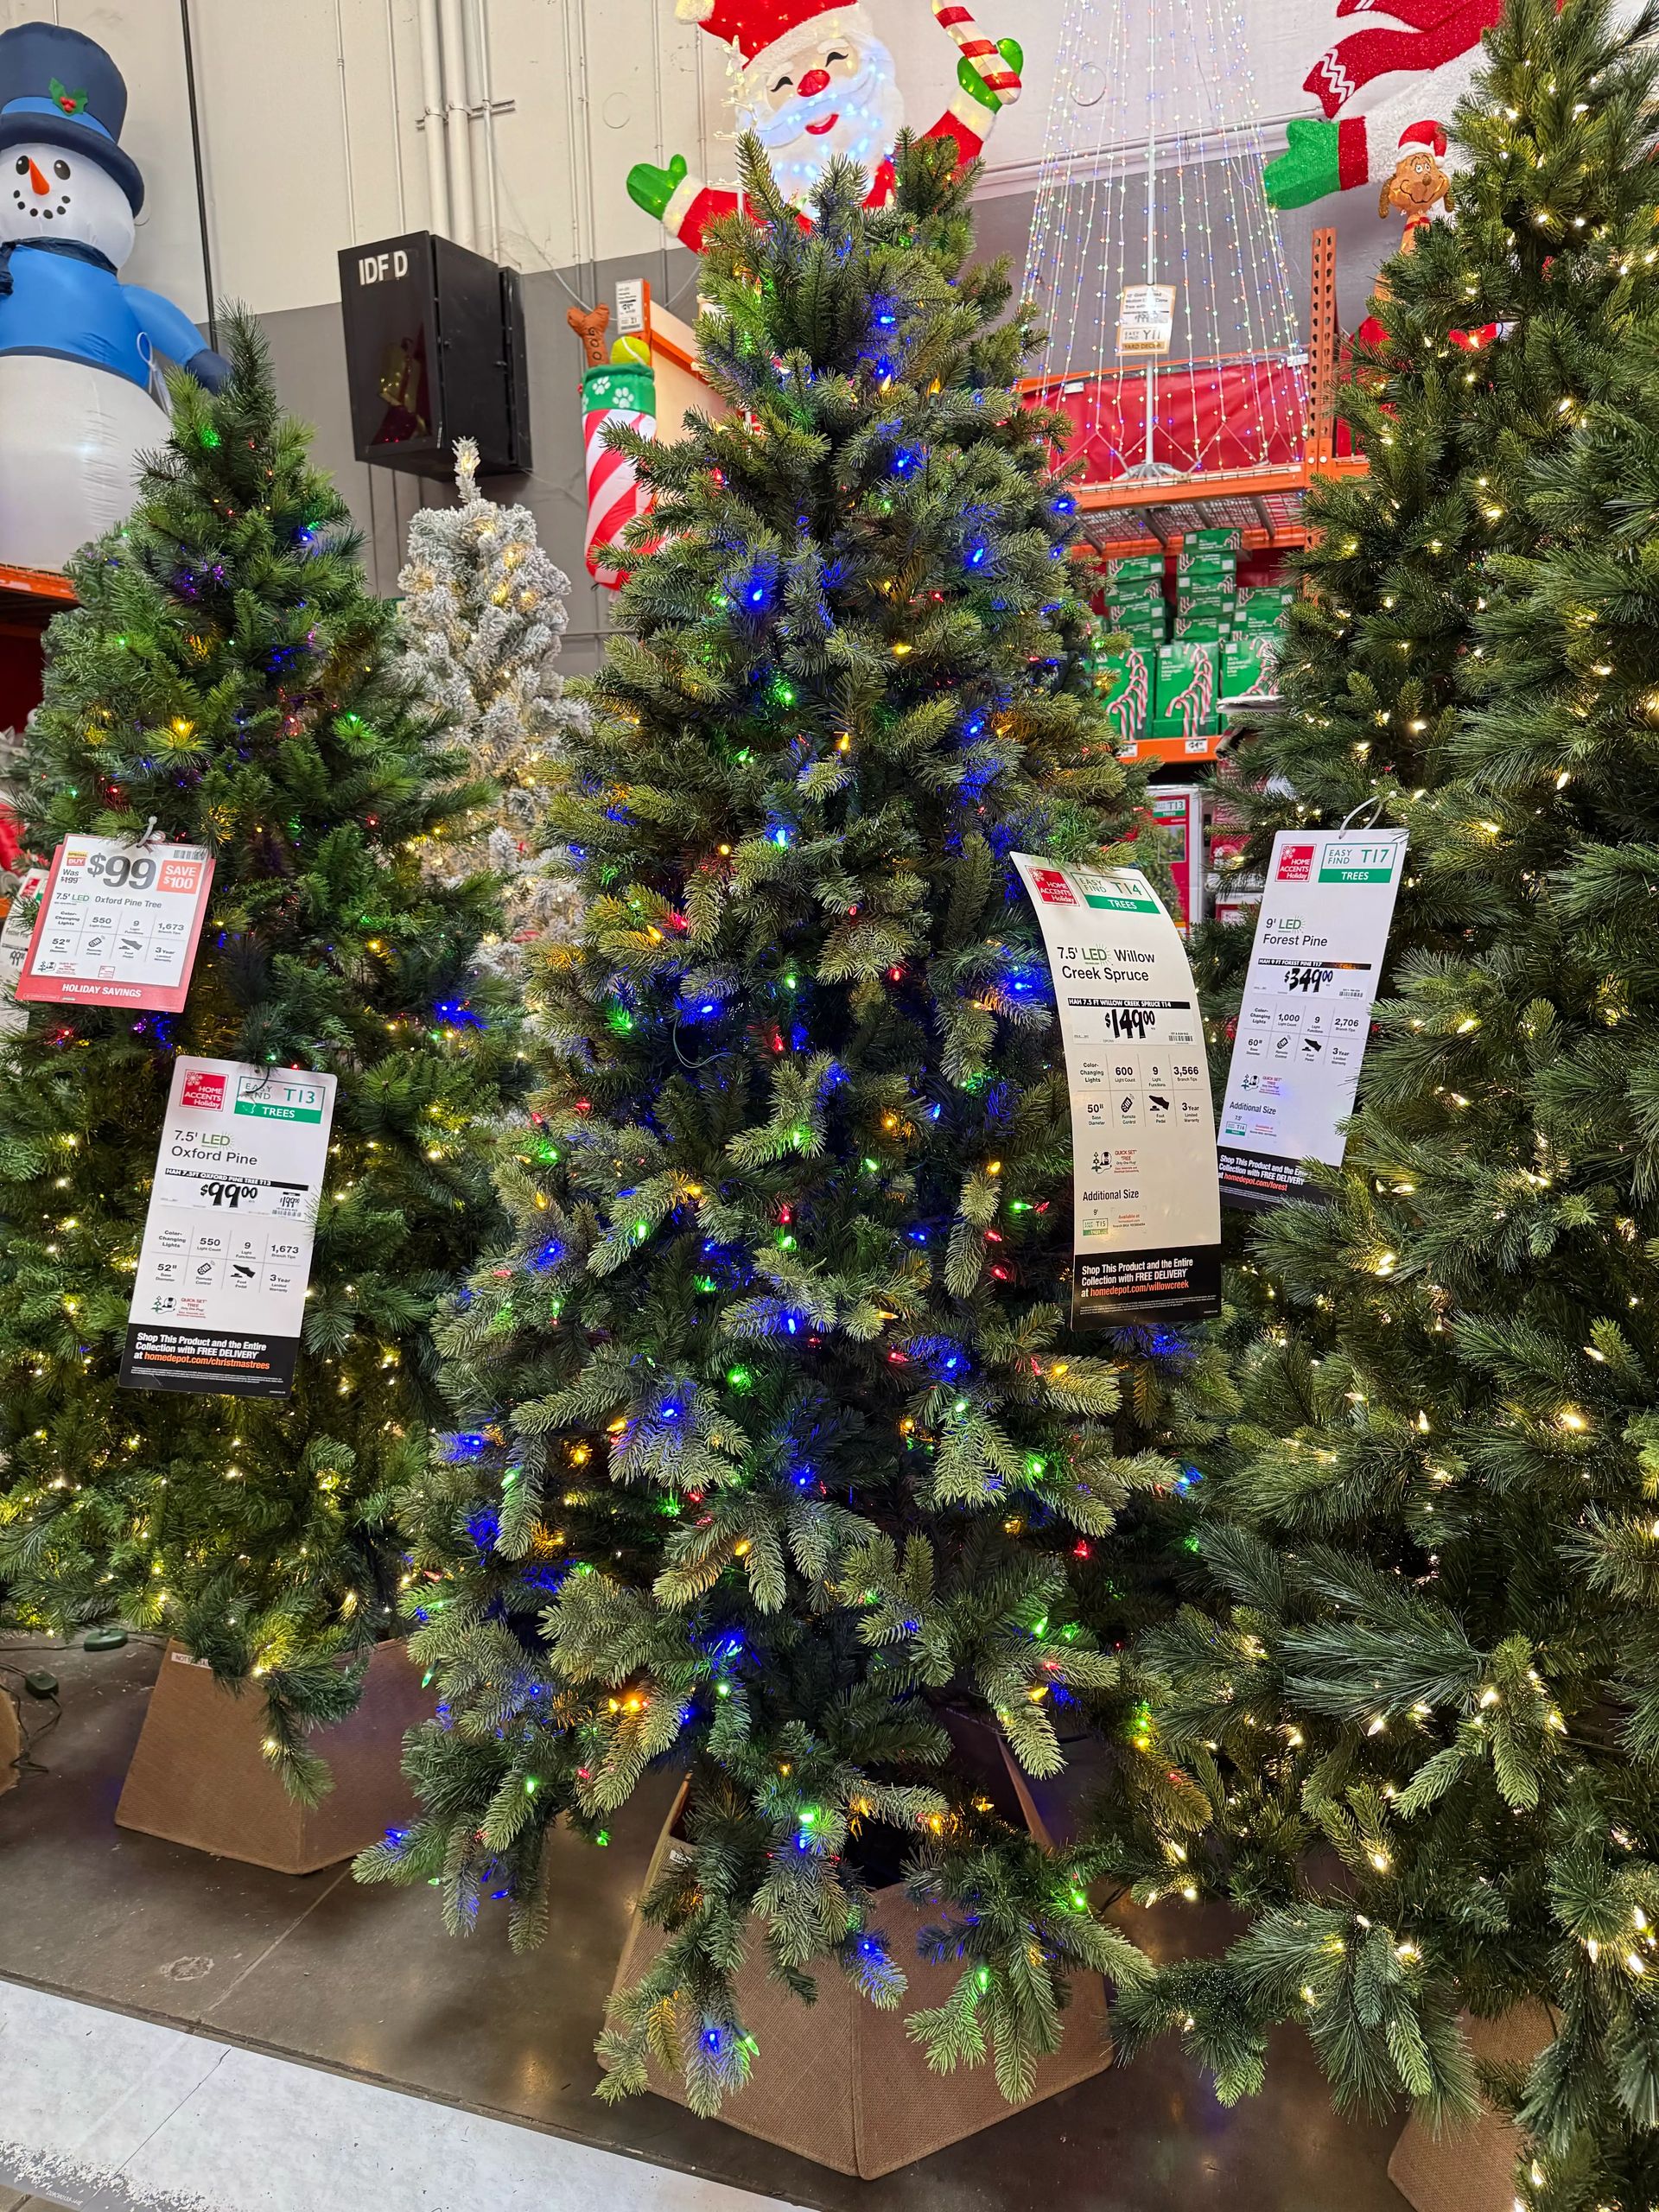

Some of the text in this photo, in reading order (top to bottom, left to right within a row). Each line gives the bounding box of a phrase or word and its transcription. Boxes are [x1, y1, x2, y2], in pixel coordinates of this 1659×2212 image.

[358, 253, 389, 285] IDF
[1361, 849, 1389, 863] T17
[87, 853, 156, 890] $99
[165, 865, 196, 876] SAVE
[1341, 871, 1369, 880] TREES
[163, 876, 194, 889] $100
[1110, 881, 1142, 895] T14
[1040, 887, 1071, 896] ACCENTS
[95, 896, 122, 905] Oxford
[1051, 894, 1074, 904] Holiday
[1107, 899, 1137, 909] TREES
[1278, 919, 1302, 930] LED
[1262, 933, 1328, 947] Forest Pine
[1082, 948, 1107, 961] LED
[1114, 949, 1155, 963] Willow
[1062, 965, 1149, 983] Creek Spruce
[62, 983, 142, 997] HOLIDAY SAVINGS
[1279, 1014, 1300, 1022] 1,000
[1335, 1018, 1359, 1027] 2,706
[1115, 1066, 1133, 1076] 600
[1152, 1066, 1159, 1075] 9
[1173, 1066, 1199, 1077] 3,566
[184, 1092, 221, 1102] ACCENTS
[199, 1086, 222, 1095] HOME
[283, 1087, 315, 1104] T13
[194, 1099, 219, 1109] Holiday
[1181, 1102, 1188, 1111] 3
[1230, 1101, 1276, 1115] Additional Size
[262, 1106, 296, 1118] TREES
[201, 1133, 231, 1147] LED
[171, 1146, 257, 1166] Oxford Pine
[1220, 1154, 1235, 1165] Shop
[1236, 1158, 1248, 1166] This
[1249, 1160, 1271, 1171] Product
[1283, 1166, 1294, 1175] the
[200, 1172, 227, 1181] OXFORD
[1219, 1163, 1246, 1174] Collection
[1261, 1171, 1276, 1180] FREE
[1224, 1173, 1287, 1192] homedepot.com/forest
[1083, 1189, 1139, 1201] Additional Size
[200, 1237, 221, 1246] 550
[271, 1244, 299, 1254] 1,673
[1082, 1257, 1193, 1276] Shop This Product and the Entire
[1082, 1275, 1116, 1287] Collection
[1118, 1274, 1134, 1283] with
[1135, 1271, 1153, 1281] FREE
[1081, 1279, 1189, 1297] at homedepot.com/willowcreek
[137, 1332, 267, 1351] Shop This Product and the Entire
[135, 1341, 175, 1353] Collection
[177, 1345, 196, 1355] with
[196, 1346, 218, 1357] FREE
[134, 1351, 270, 1370] at homedepot.com/christmastrees
